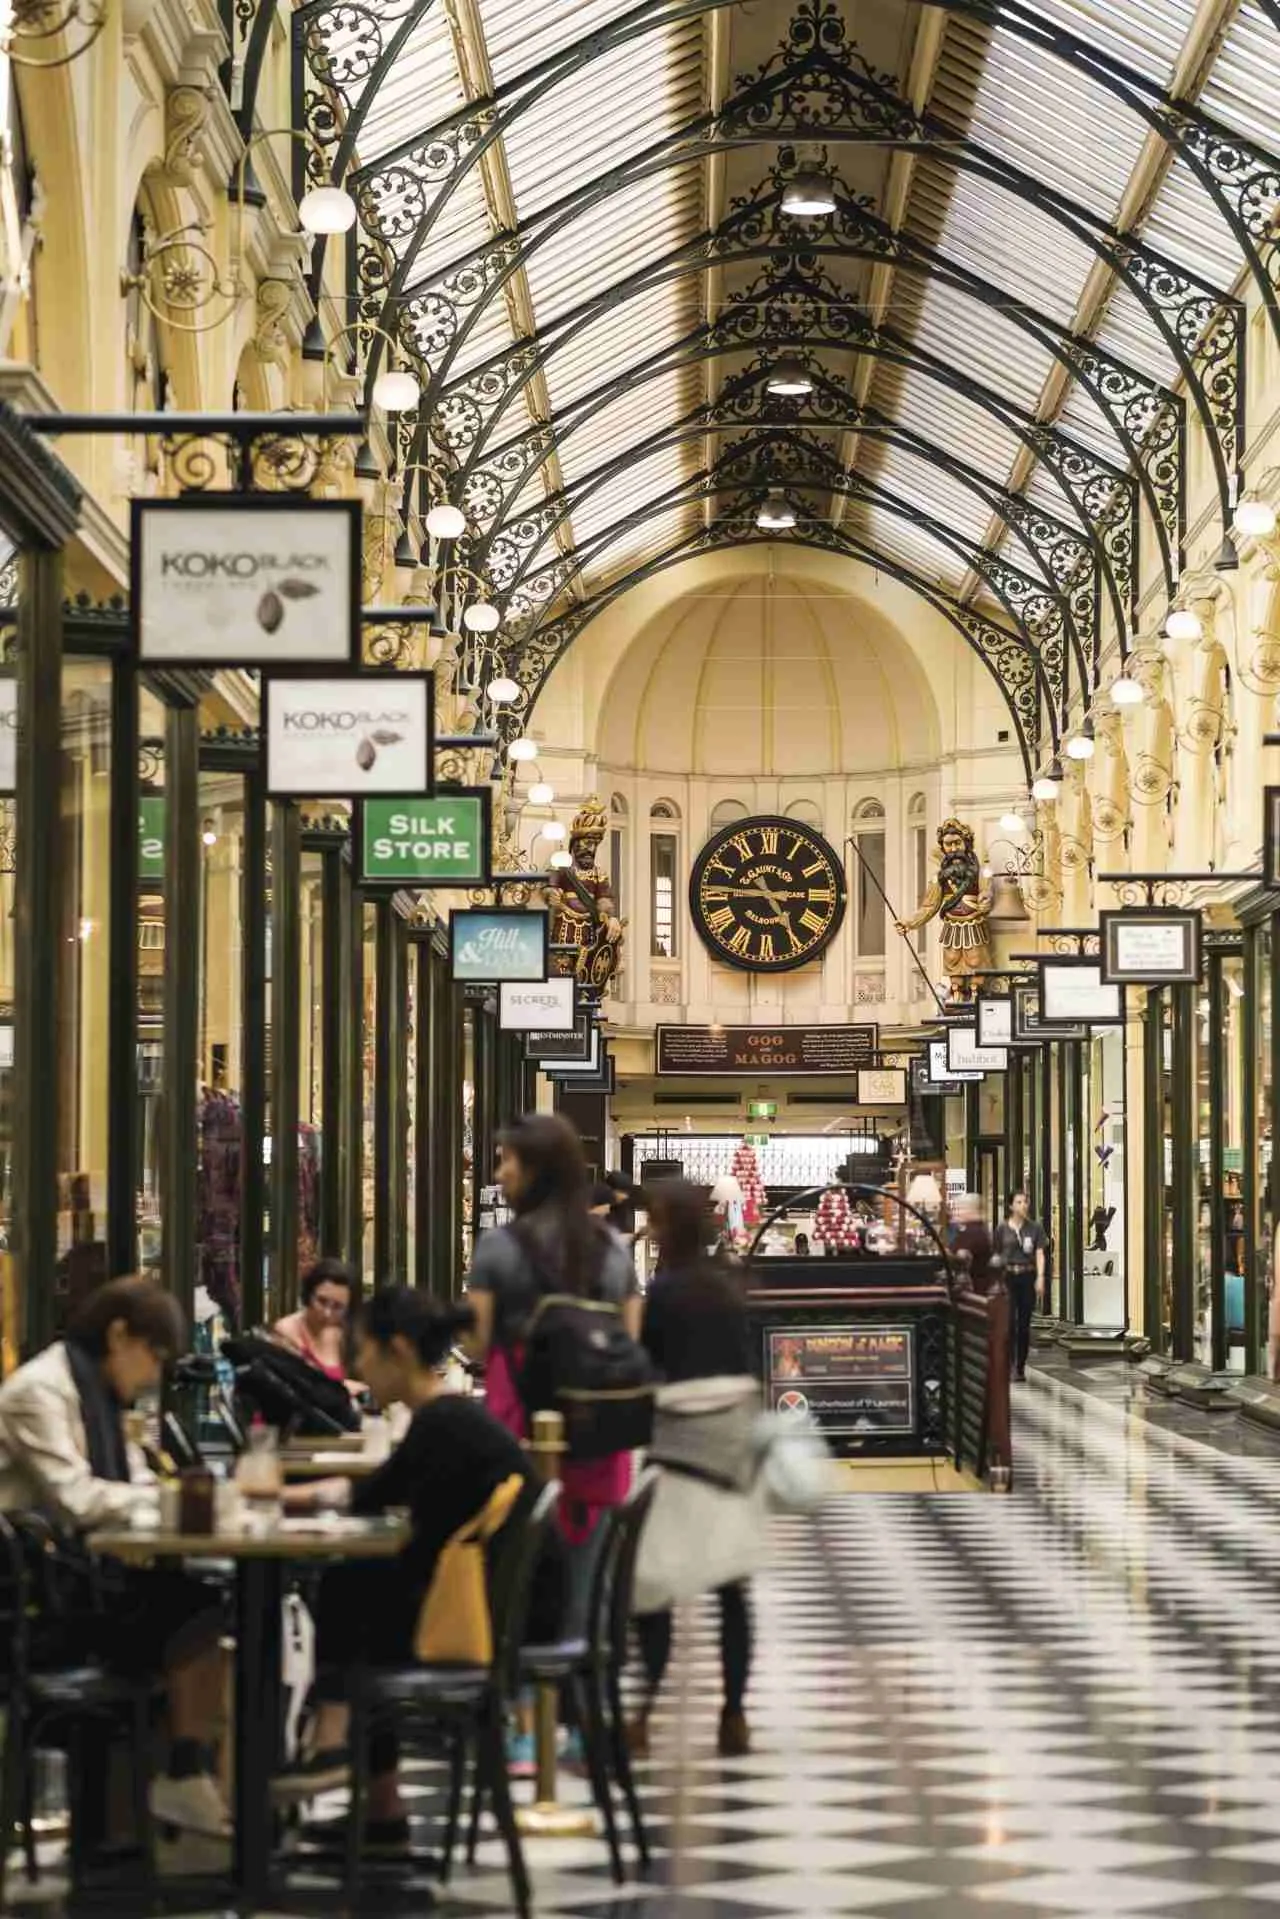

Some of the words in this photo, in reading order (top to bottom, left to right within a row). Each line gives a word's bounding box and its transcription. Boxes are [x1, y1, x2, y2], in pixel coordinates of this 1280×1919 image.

[161, 552, 258, 578] KOKO
[283, 711, 357, 731] KOKO
[389, 814, 455, 836] SILK
[373, 838, 470, 859] STORE
[760, 832, 779, 855] XII
[808, 888, 834, 902] III
[748, 1035, 784, 1046] GOG
[734, 1053, 797, 1065] MAGOG
